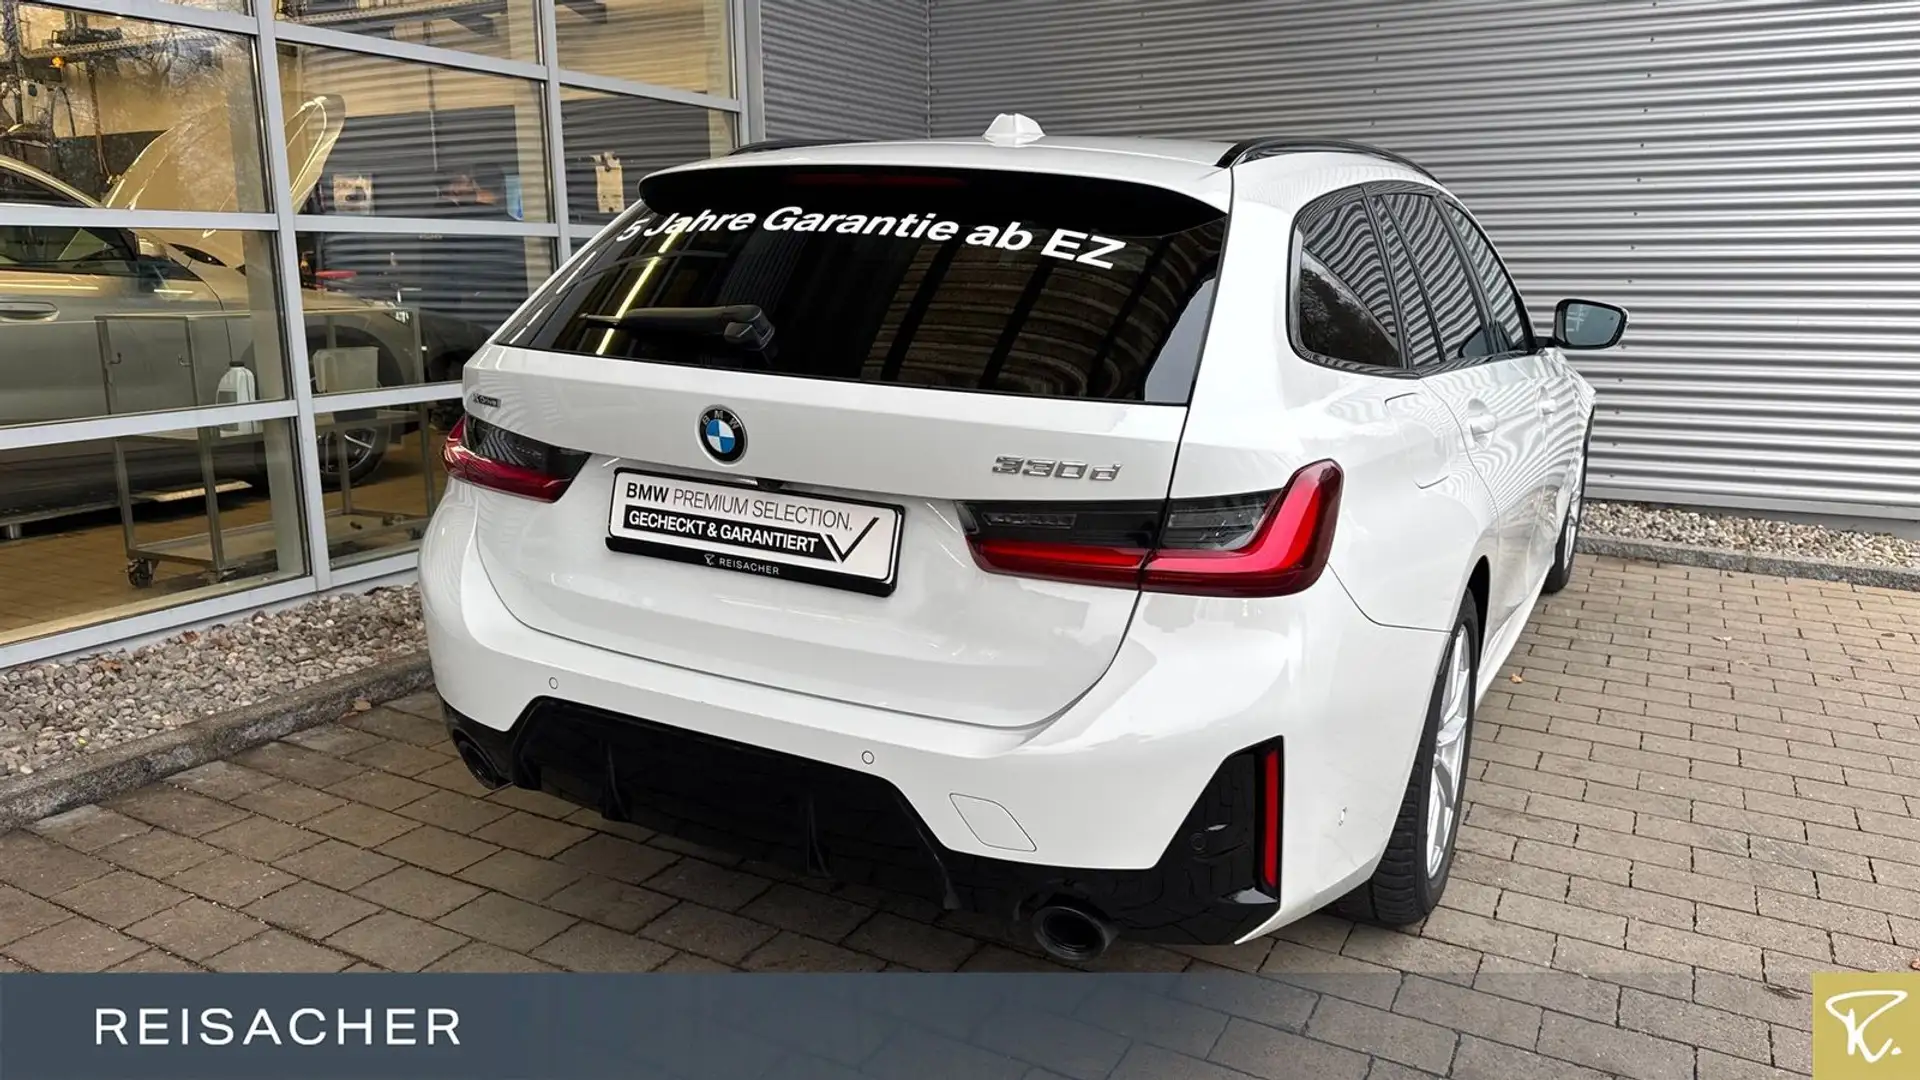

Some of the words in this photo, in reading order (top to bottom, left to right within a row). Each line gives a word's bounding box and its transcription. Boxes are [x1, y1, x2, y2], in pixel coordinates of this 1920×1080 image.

[616, 218, 649, 242] 5
[643, 208, 757, 237] Jahre
[762, 206, 960, 243] Garantie
[966, 222, 1034, 251] ab
[1040, 228, 1127, 270] EZ
[702, 410, 740, 430] BMW
[625, 482, 669, 503] BMW
[673, 488, 749, 516] PREMIUM
[628, 510, 706, 536] GECHECKT
[707, 523, 718, 537] &
[720, 524, 819, 553] GARANTIERT
[719, 557, 780, 575] REISACHER
